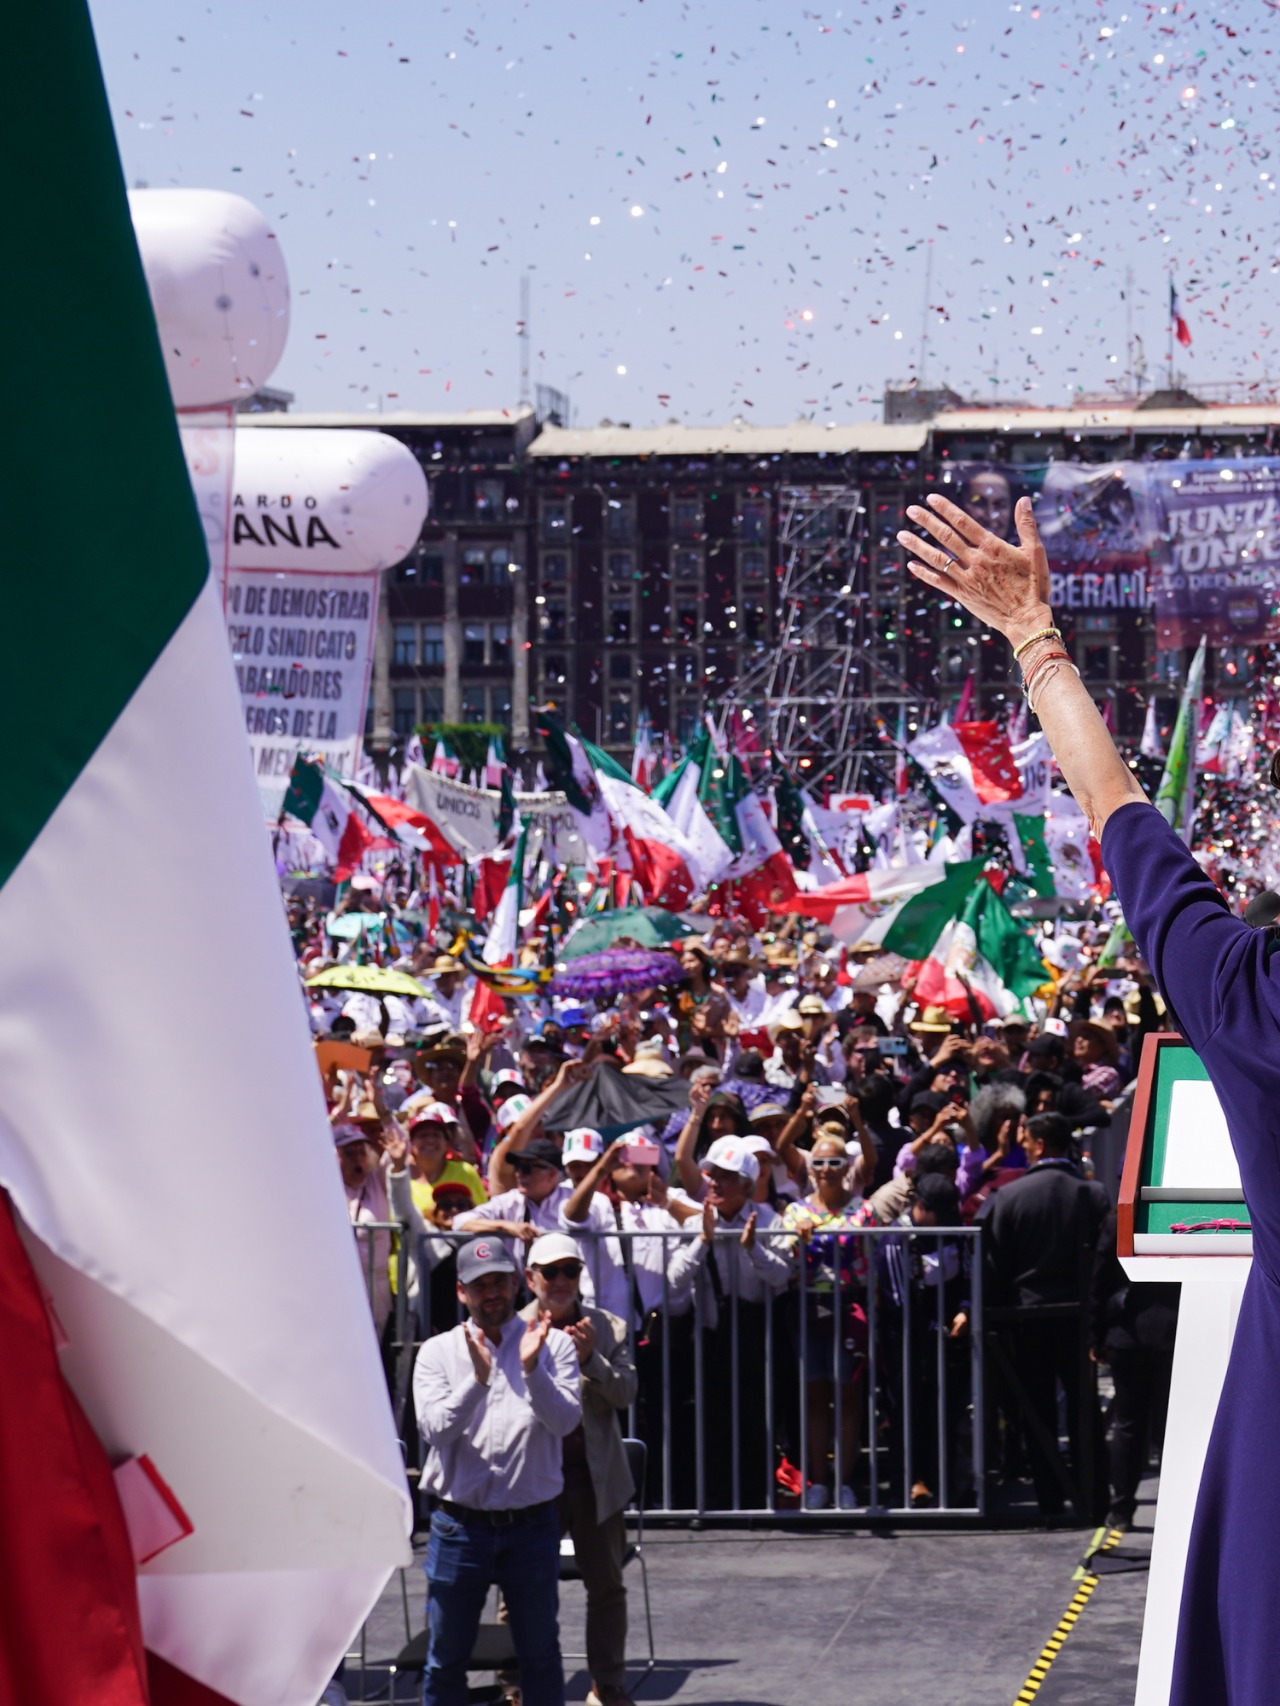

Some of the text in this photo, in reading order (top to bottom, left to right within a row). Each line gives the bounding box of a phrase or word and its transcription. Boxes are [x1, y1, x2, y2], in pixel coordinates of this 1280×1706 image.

[244, 586, 267, 616] DE
[269, 587, 369, 620] DEMOSTRAR
[267, 626, 356, 660] SINDICATO
[292, 709, 313, 738] DE
[316, 710, 337, 740] LA
[475, 1243, 491, 1260] C
